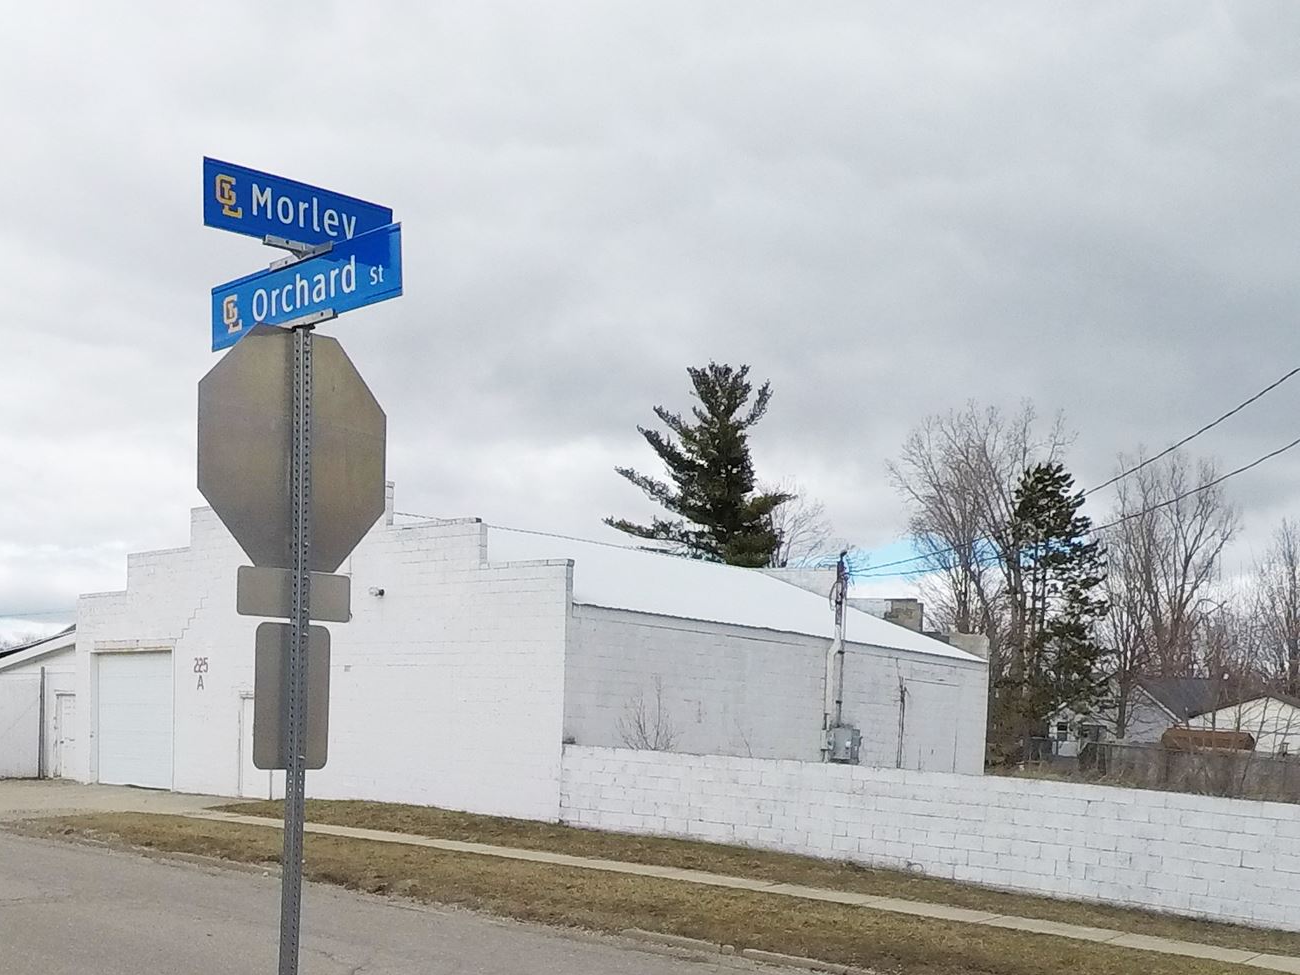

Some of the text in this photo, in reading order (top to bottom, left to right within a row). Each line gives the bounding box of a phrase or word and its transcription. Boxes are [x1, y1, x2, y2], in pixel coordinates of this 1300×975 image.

[251, 183, 357, 239] Morley
[252, 254, 356, 322] Orchard
[193, 657, 208, 673] 225
[196, 674, 204, 690] A
